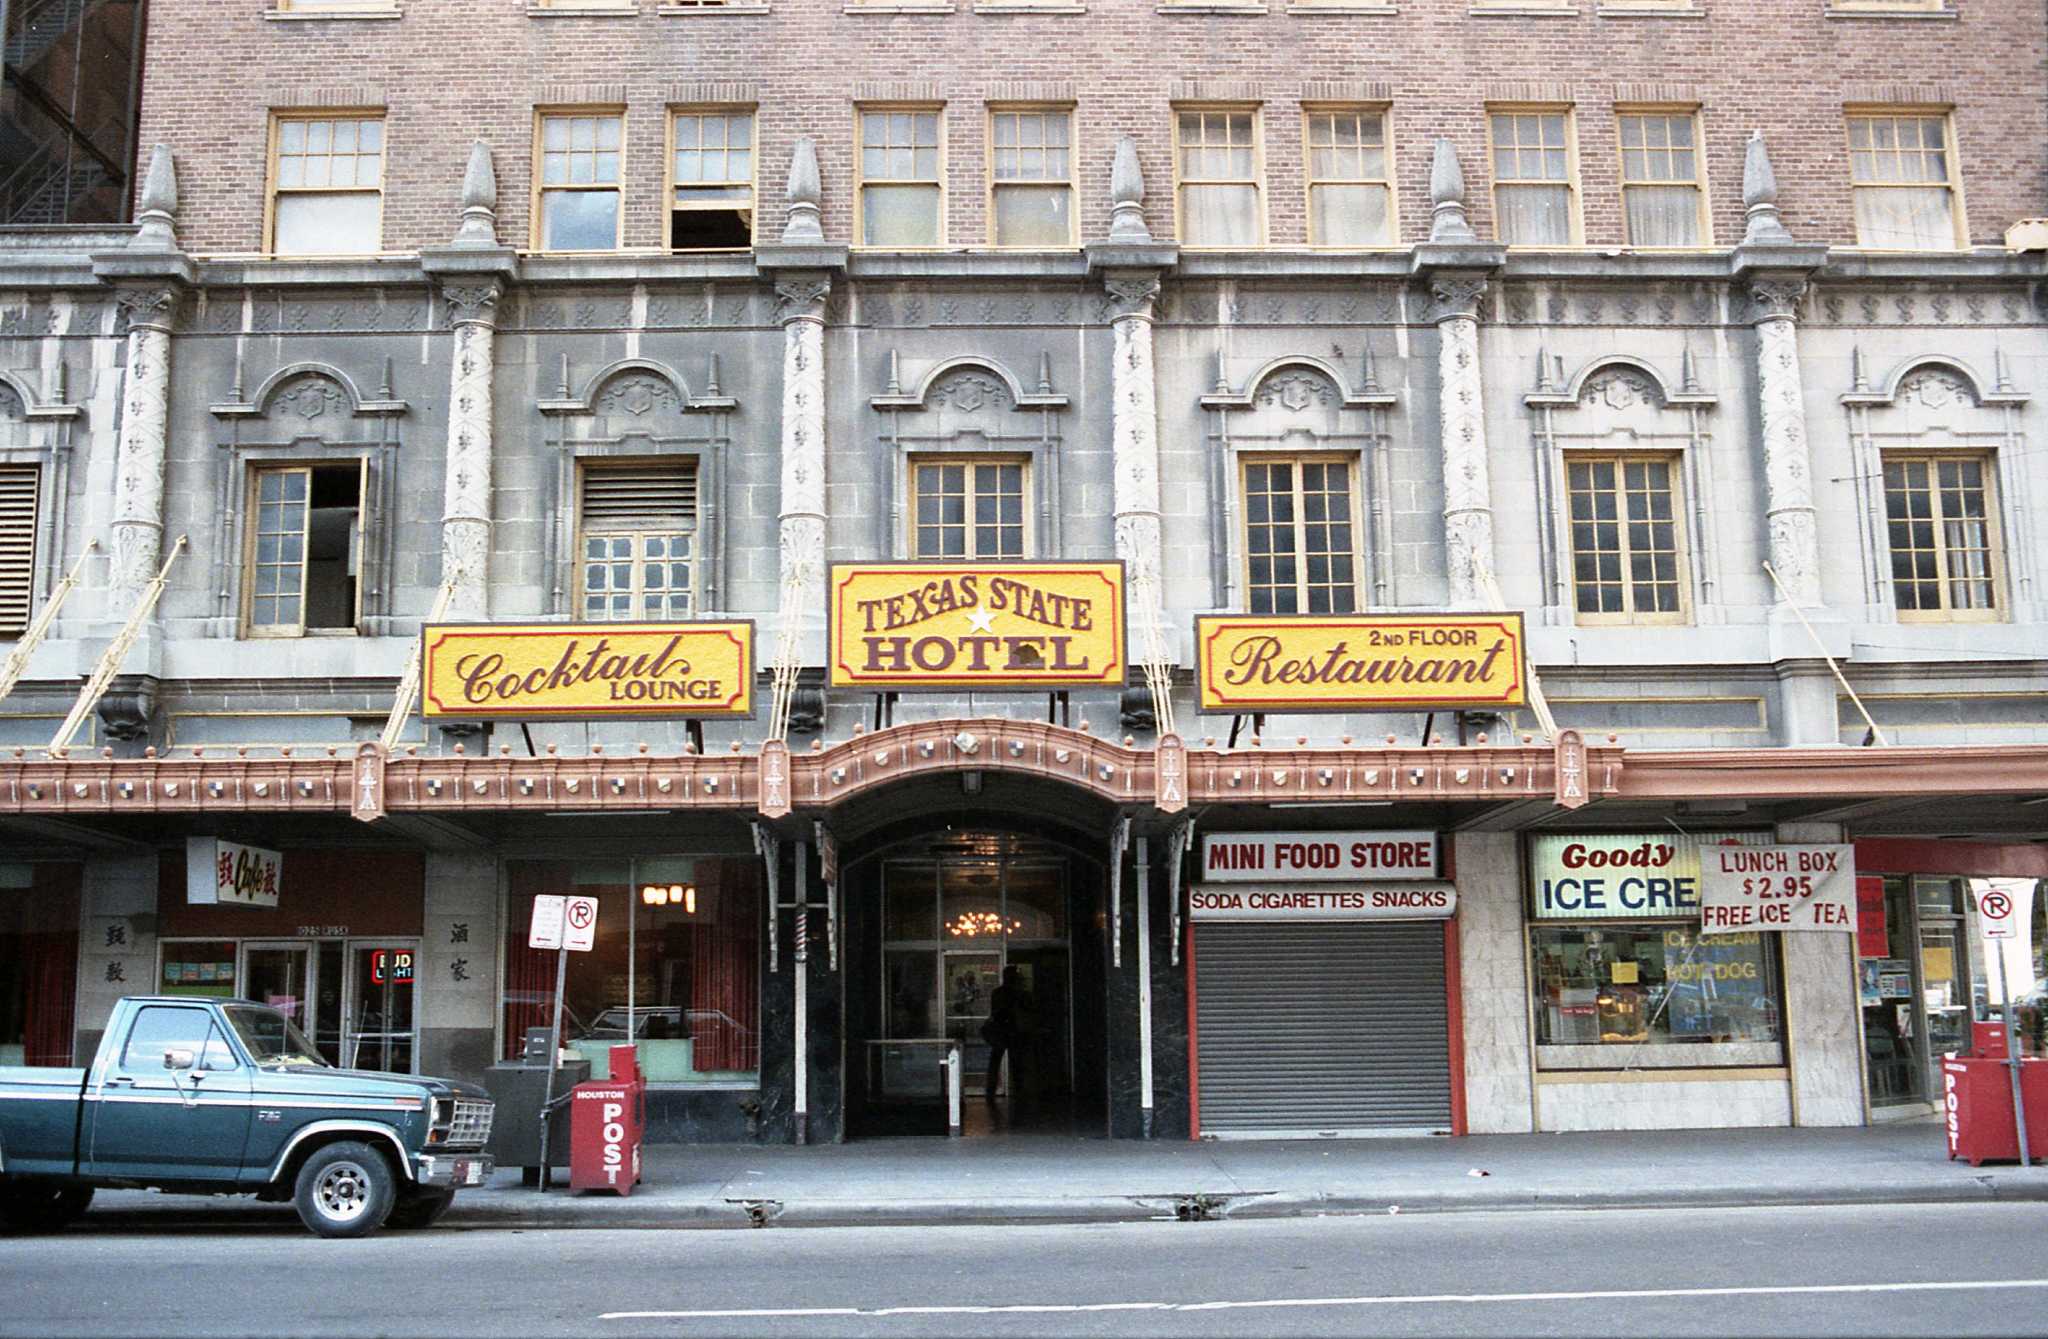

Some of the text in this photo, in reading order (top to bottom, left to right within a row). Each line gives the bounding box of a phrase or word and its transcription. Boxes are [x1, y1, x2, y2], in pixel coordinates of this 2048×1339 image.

[857, 575, 1092, 632] TEXAS STATE
[1369, 630, 1478, 646] 2ND FLOOR
[862, 636, 1089, 671] HOTEL
[1224, 636, 1505, 685] Restaurant
[456, 635, 691, 703] Cocktail
[609, 680, 722, 700] LOUNGE
[1208, 842, 1432, 869] MINI FOOD STORE
[1562, 843, 1675, 869] Goody
[1720, 851, 1838, 872] LUNCH BOX
[1543, 877, 1701, 910] ICE CRE
[1743, 876, 1812, 898] $2.95
[1191, 891, 1447, 909] SODA CIGARETTES SNACKS
[1703, 903, 1849, 926] FREE ICE TEA
[376, 967, 412, 978] LHT
[1715, 962, 1757, 980] DOG
[577, 1091, 625, 1099] HOUSTON
[1945, 1073, 1959, 1151] POST
[603, 1103, 624, 1184] POST
